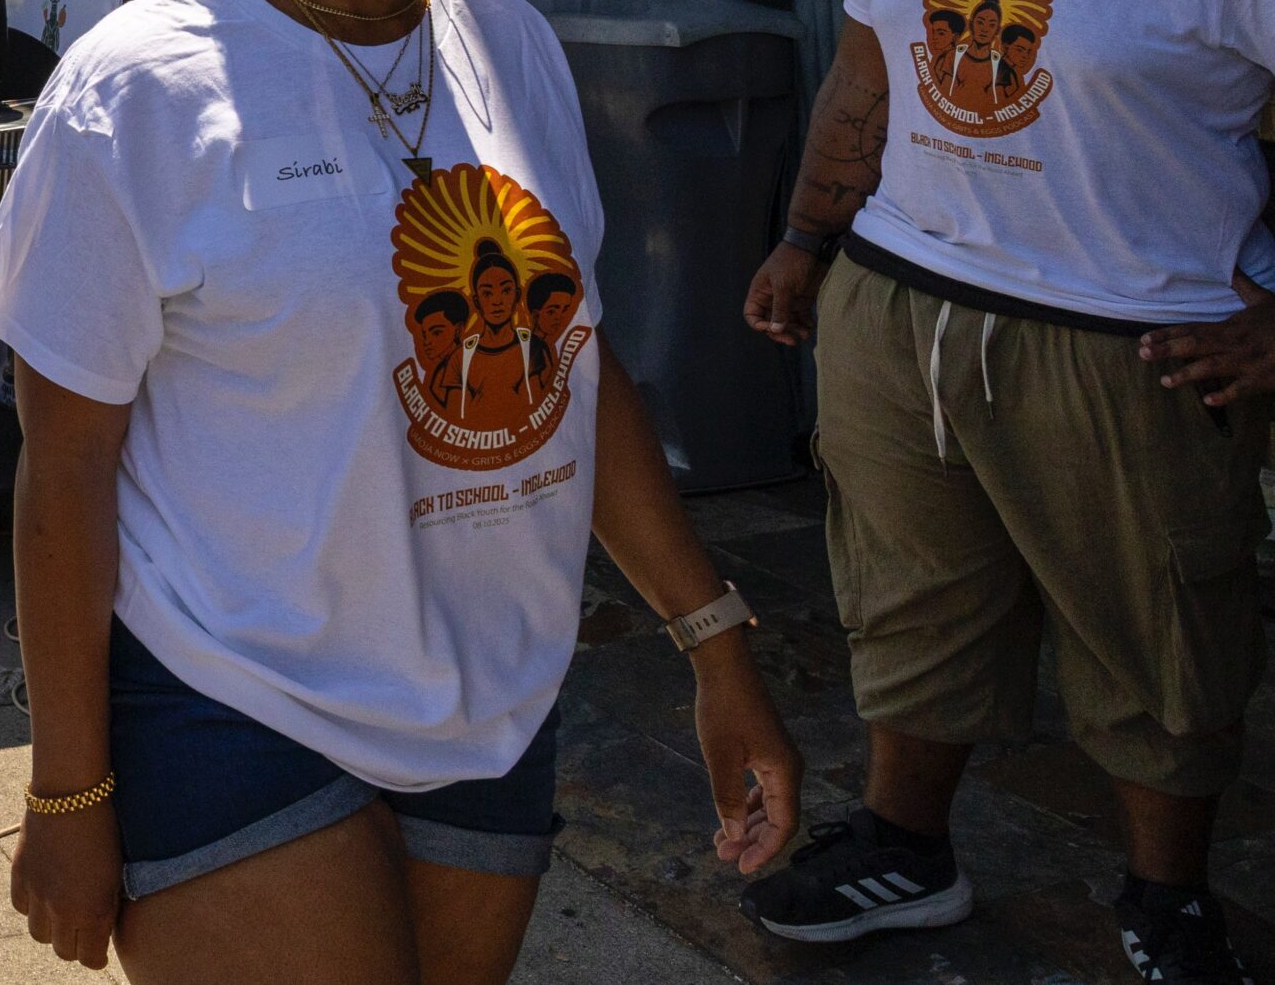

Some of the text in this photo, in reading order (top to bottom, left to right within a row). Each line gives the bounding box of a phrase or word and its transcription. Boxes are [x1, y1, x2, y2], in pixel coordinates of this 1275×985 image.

[914, 45, 932, 86] BLACK
[928, 84, 942, 101] TO
[938, 96, 984, 125] SCHOOL
[994, 71, 1051, 123] INGLEWOOD
[277, 157, 343, 181] Sirabi
[932, 138, 943, 151] TO
[984, 151, 1043, 172] INGLEWOOD
[398, 365, 430, 422] BLACK
[424, 411, 448, 439] TO
[443, 424, 516, 450] SCHOOL
[529, 330, 587, 430] INGLEWOOD
[434, 448, 460, 463] NOW
[472, 455, 502, 466] GRITS
[513, 437, 539, 459] EGGS
[410, 495, 434, 528] ACK
[437, 492, 454, 512] TO
[455, 484, 509, 507] SCHOOL
[521, 460, 577, 497] INGLEWOOD
[476, 507, 499, 517] Youth
[499, 506, 511, 514] for
[512, 503, 524, 512] the
